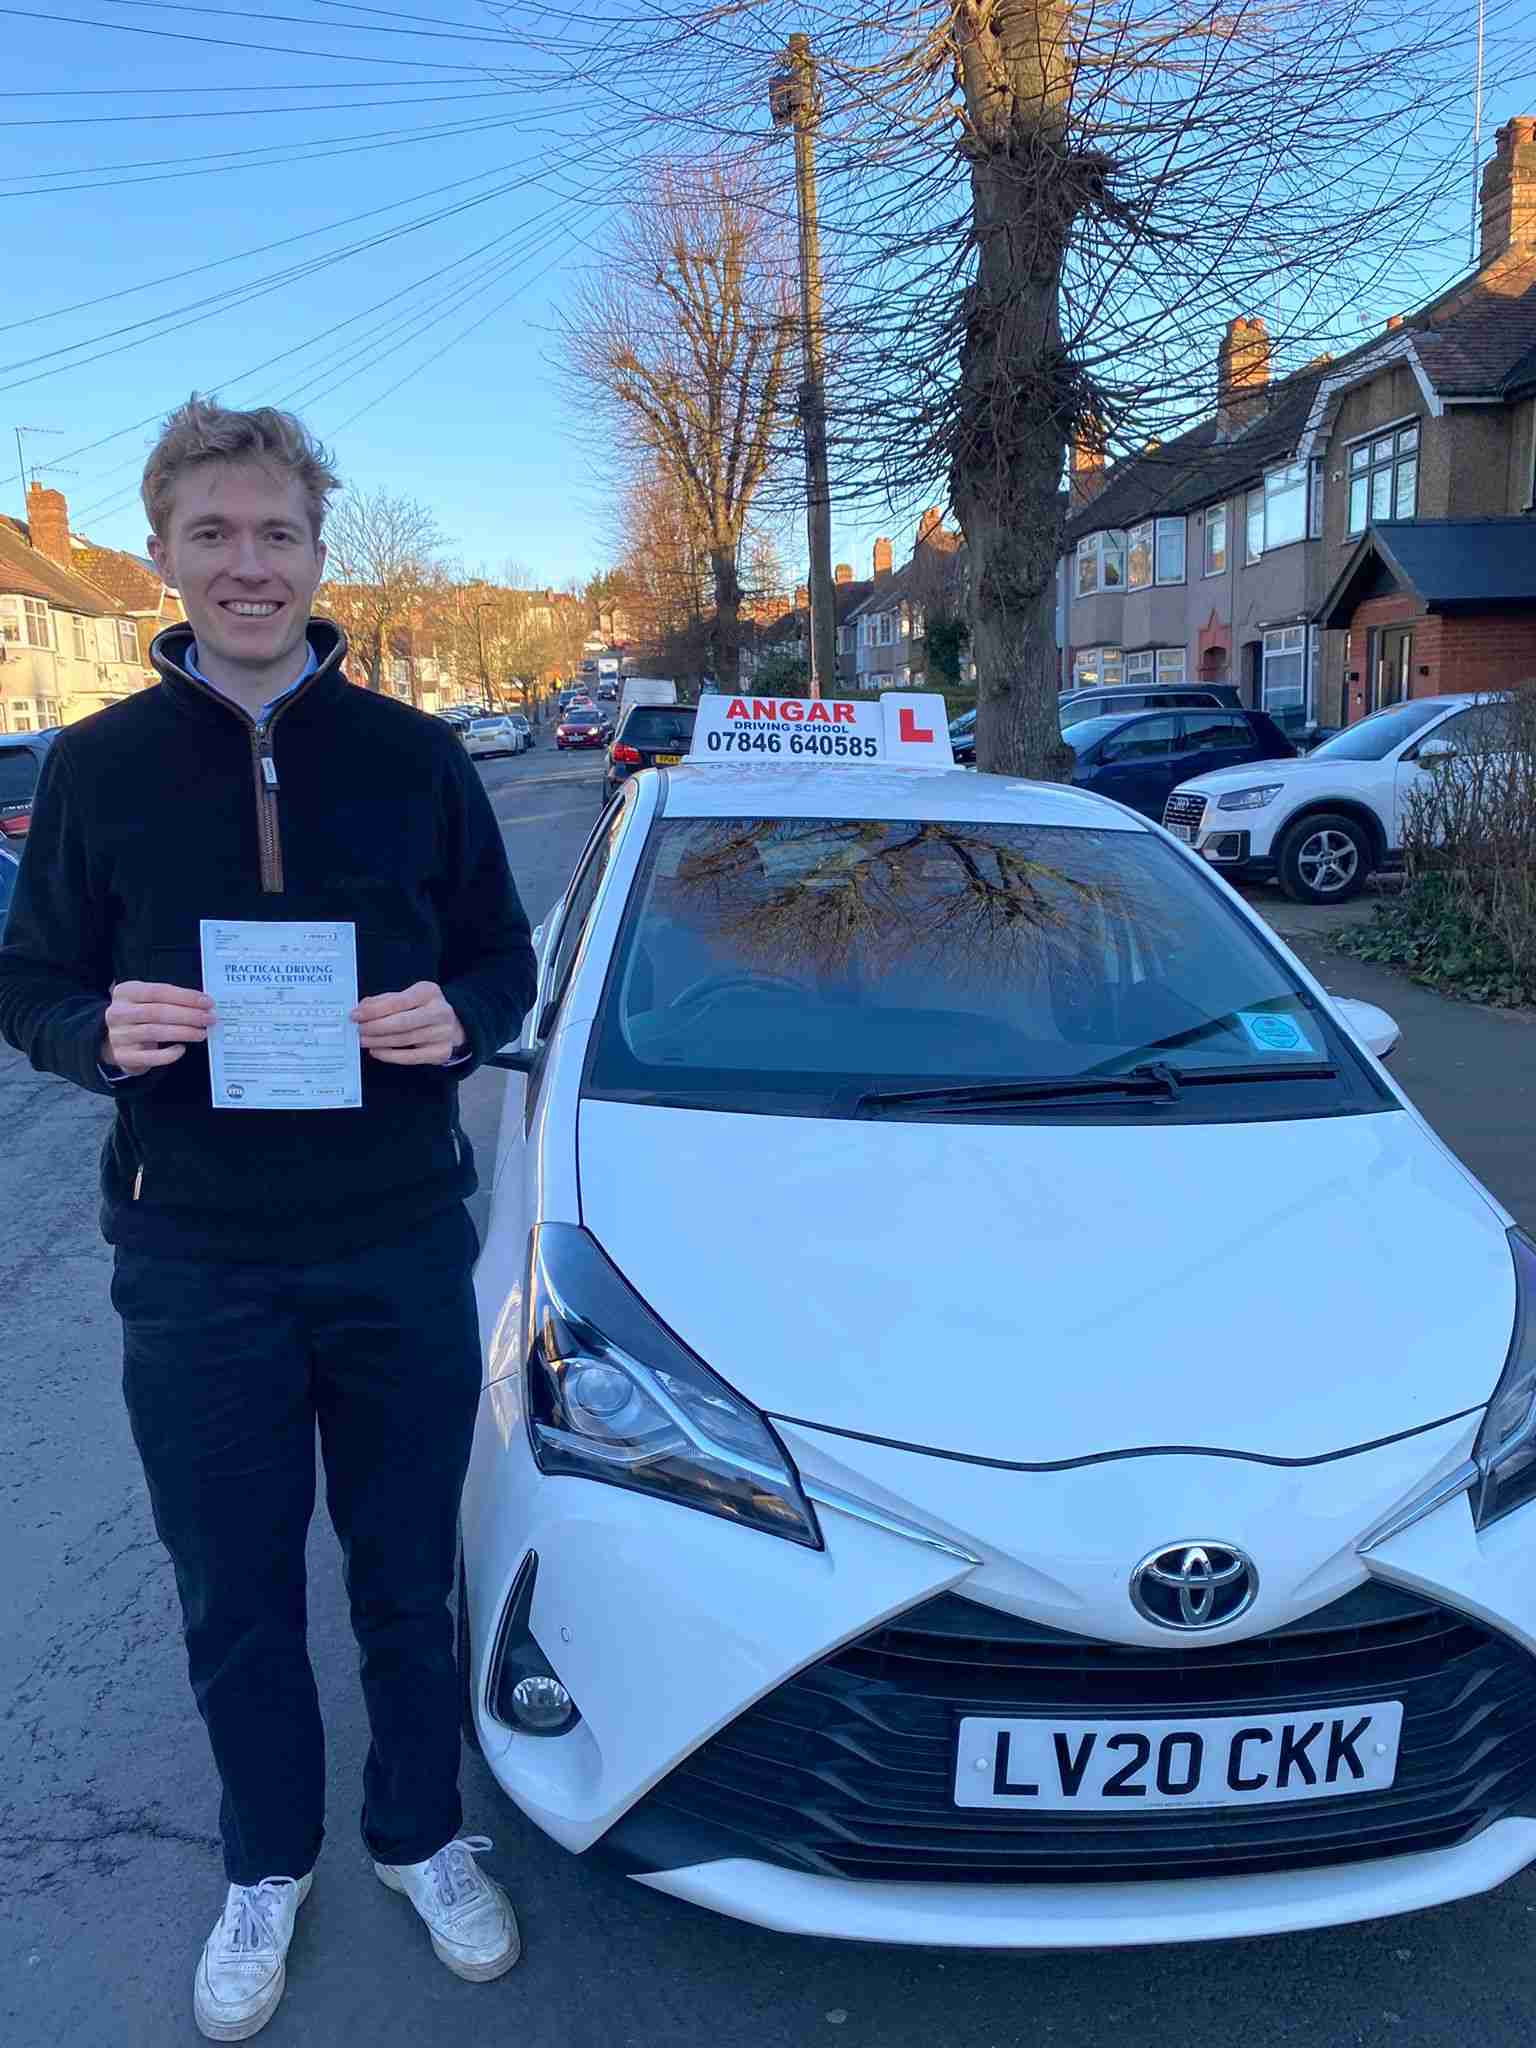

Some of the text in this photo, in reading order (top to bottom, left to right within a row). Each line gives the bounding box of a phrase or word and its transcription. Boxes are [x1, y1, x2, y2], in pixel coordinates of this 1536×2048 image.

[726, 699, 856, 723] ANGAR
[734, 721, 848, 733] DRIVING SCHOOL
[899, 709, 934, 742] L
[707, 732, 878, 757] 07846 640585
[225, 965, 333, 973] PRACTICAL DRIVING
[226, 974, 248, 983] TEST
[249, 974, 272, 983] PASS
[993, 1716, 1373, 1797] LV20 CKK
